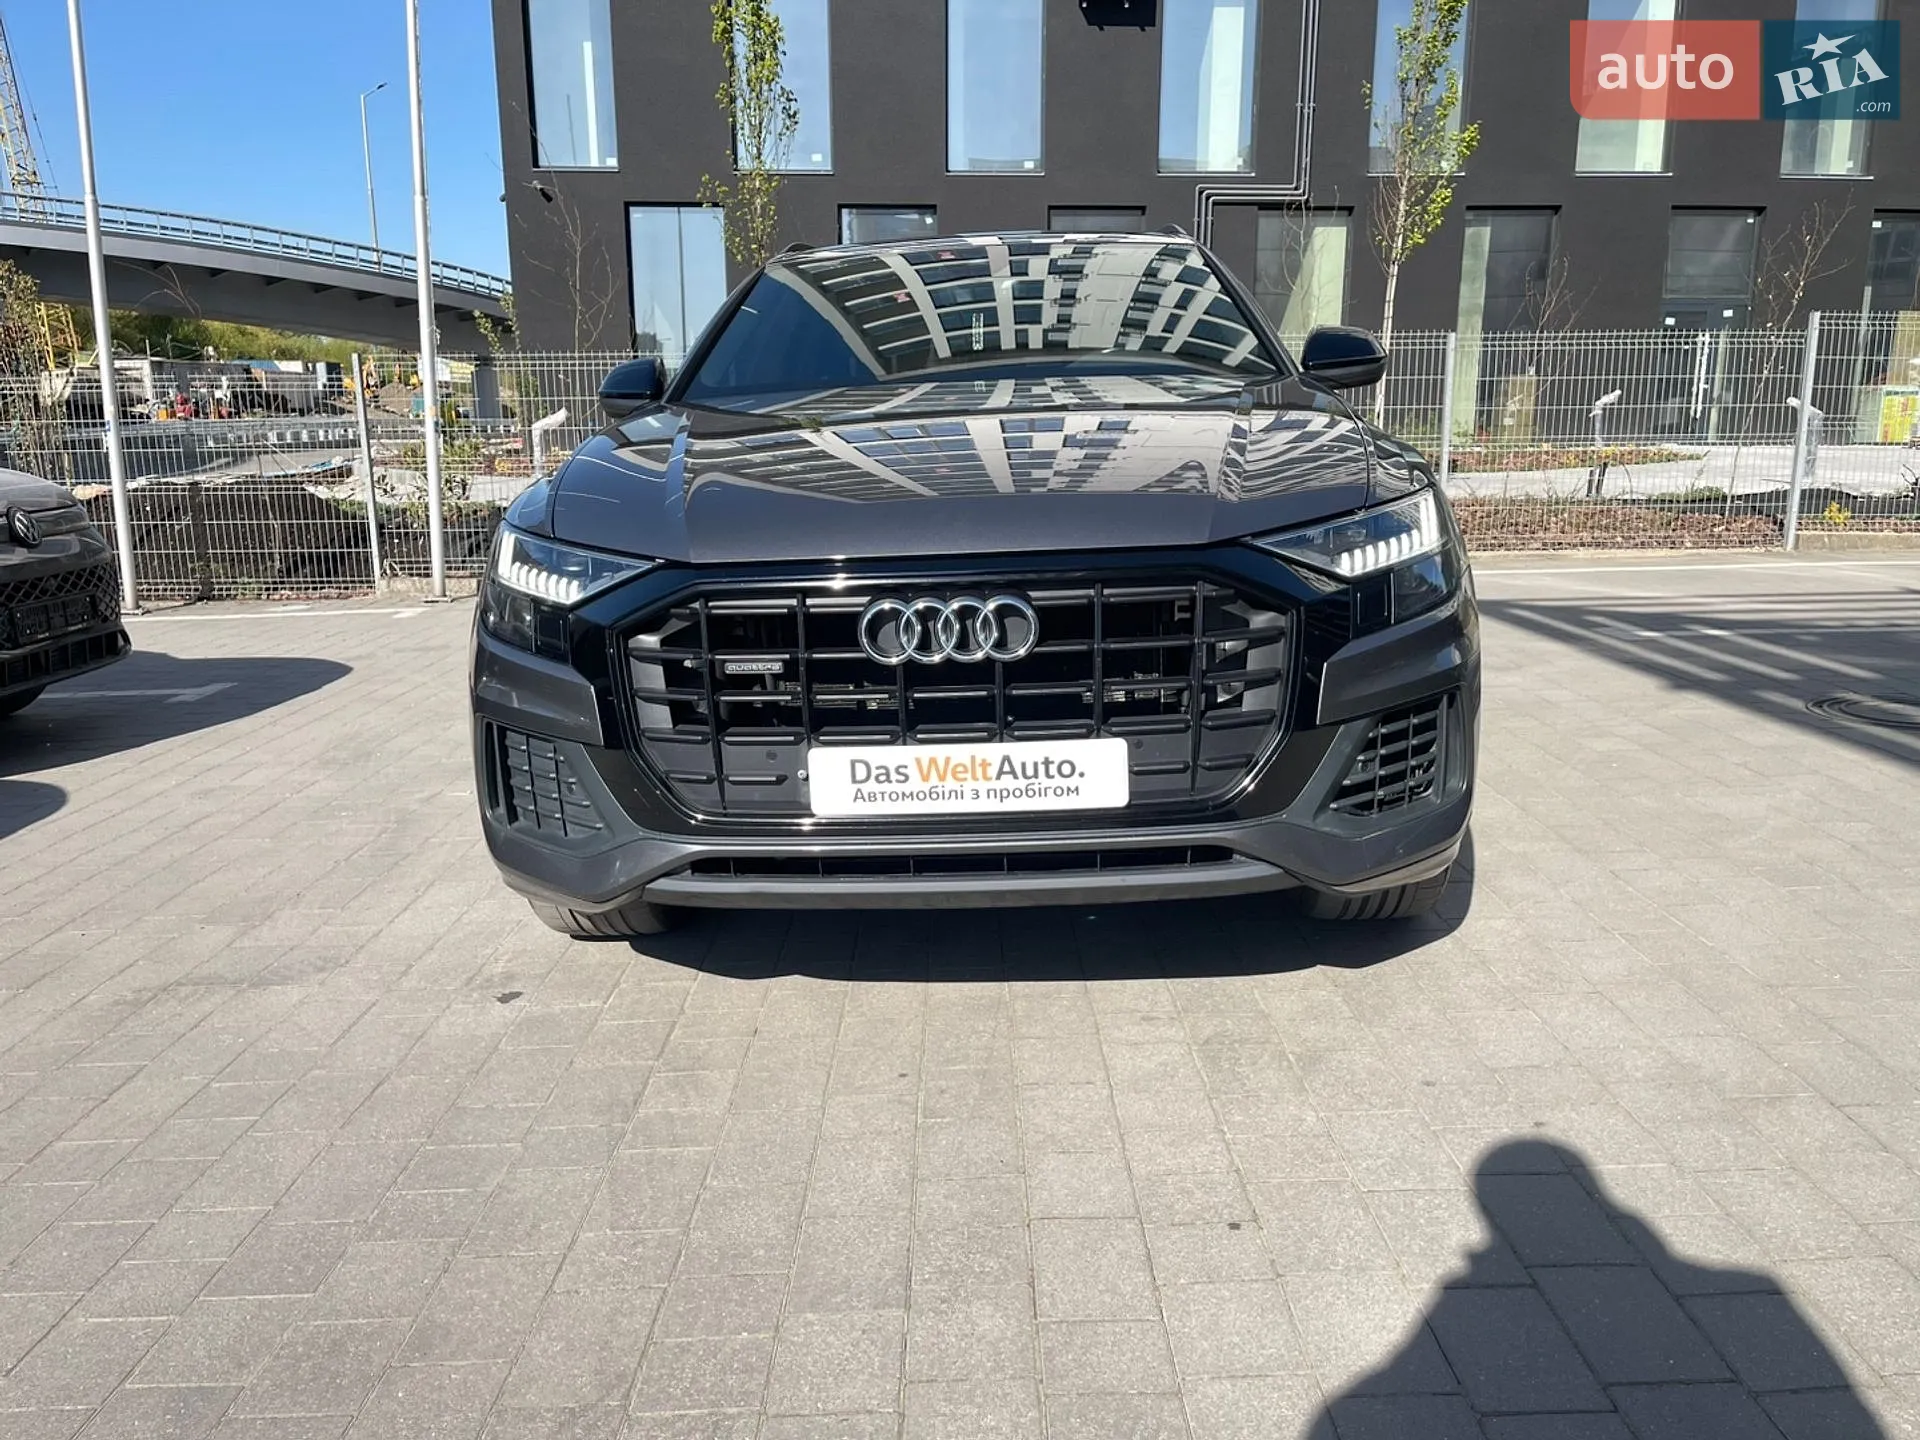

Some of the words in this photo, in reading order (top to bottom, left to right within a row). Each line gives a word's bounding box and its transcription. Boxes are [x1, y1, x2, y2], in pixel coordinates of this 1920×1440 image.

[849, 758, 910, 785] Das
[852, 784, 965, 803] Автомобілі
[971, 788, 980, 800] з
[986, 782, 1080, 801] пробігом
